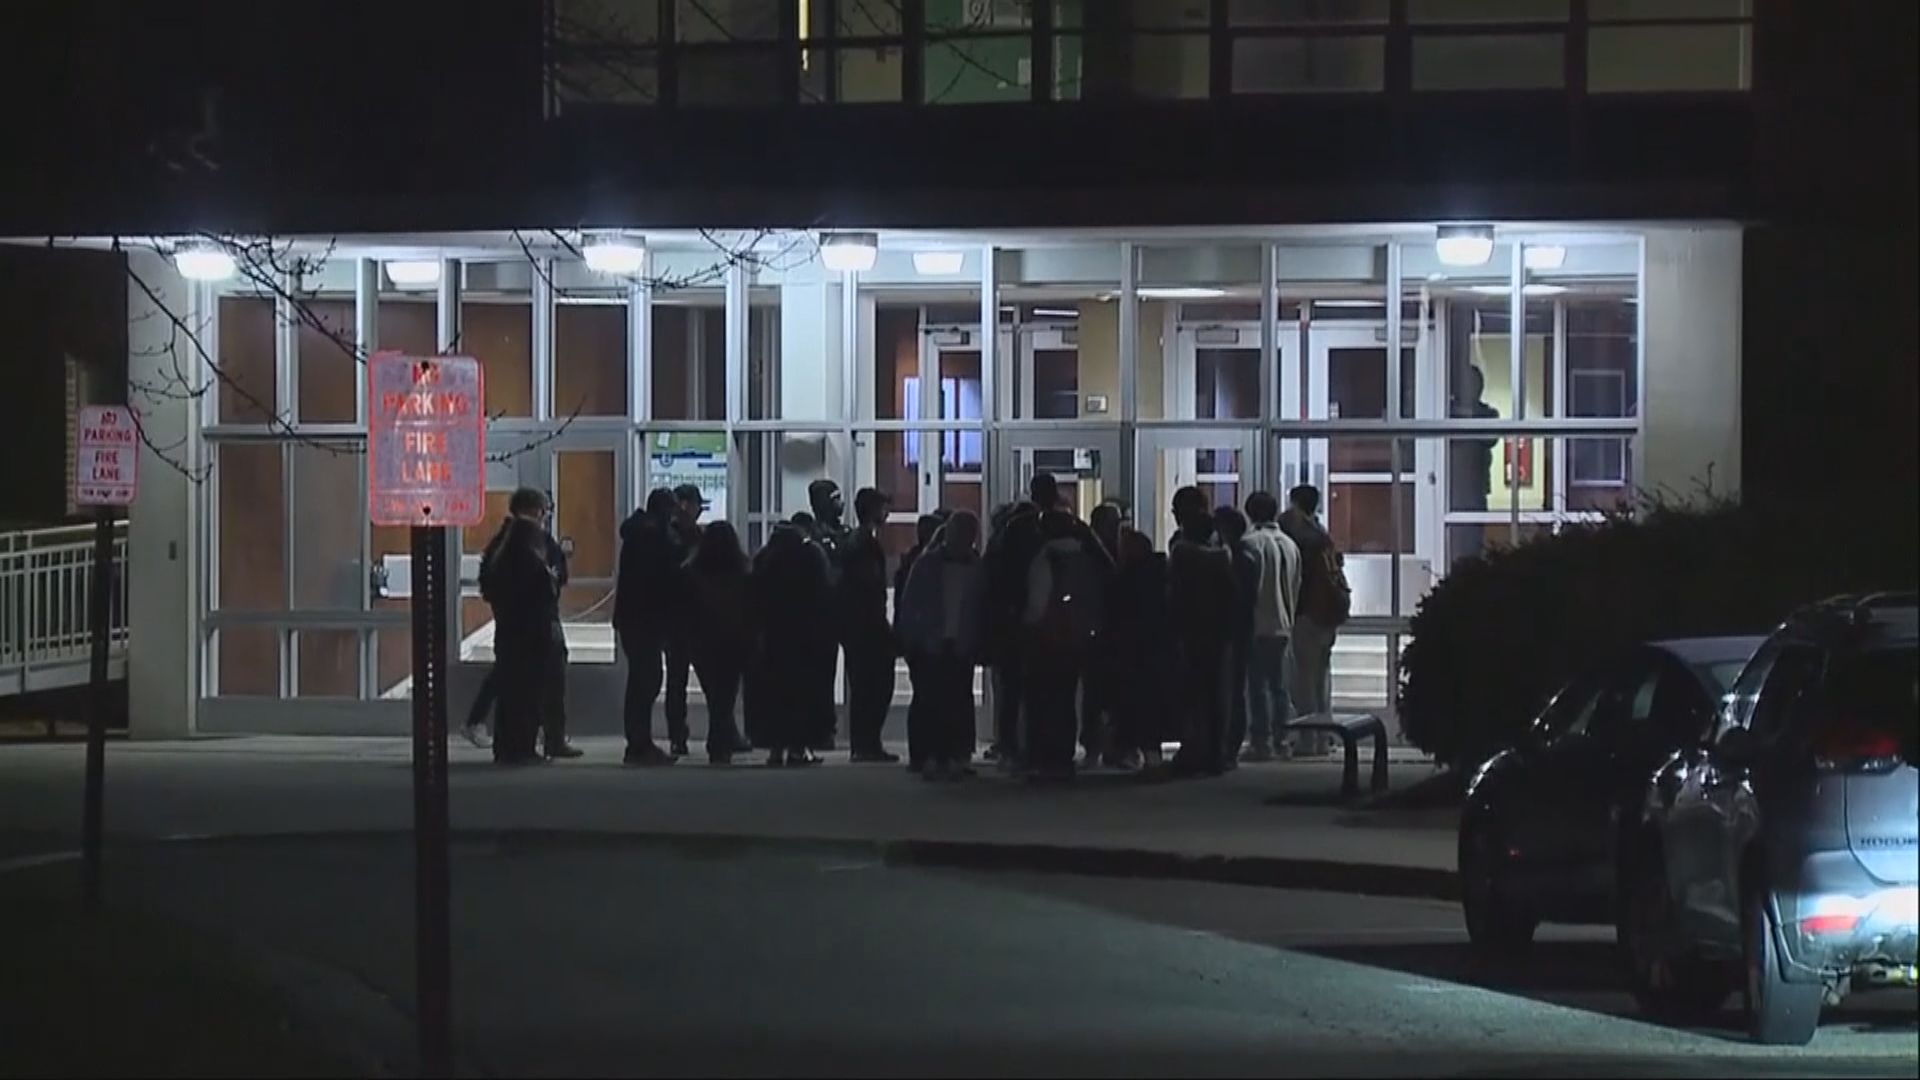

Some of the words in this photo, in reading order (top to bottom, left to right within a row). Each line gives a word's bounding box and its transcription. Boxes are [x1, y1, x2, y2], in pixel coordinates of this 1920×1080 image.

[383, 392, 469, 416] PARKING
[101, 412, 117, 425] NO
[84, 428, 132, 442] PARKING
[404, 431, 448, 455] FIRE
[95, 450, 119, 464] FIRE
[92, 467, 120, 481] LANE
[401, 459, 451, 483] LANE
